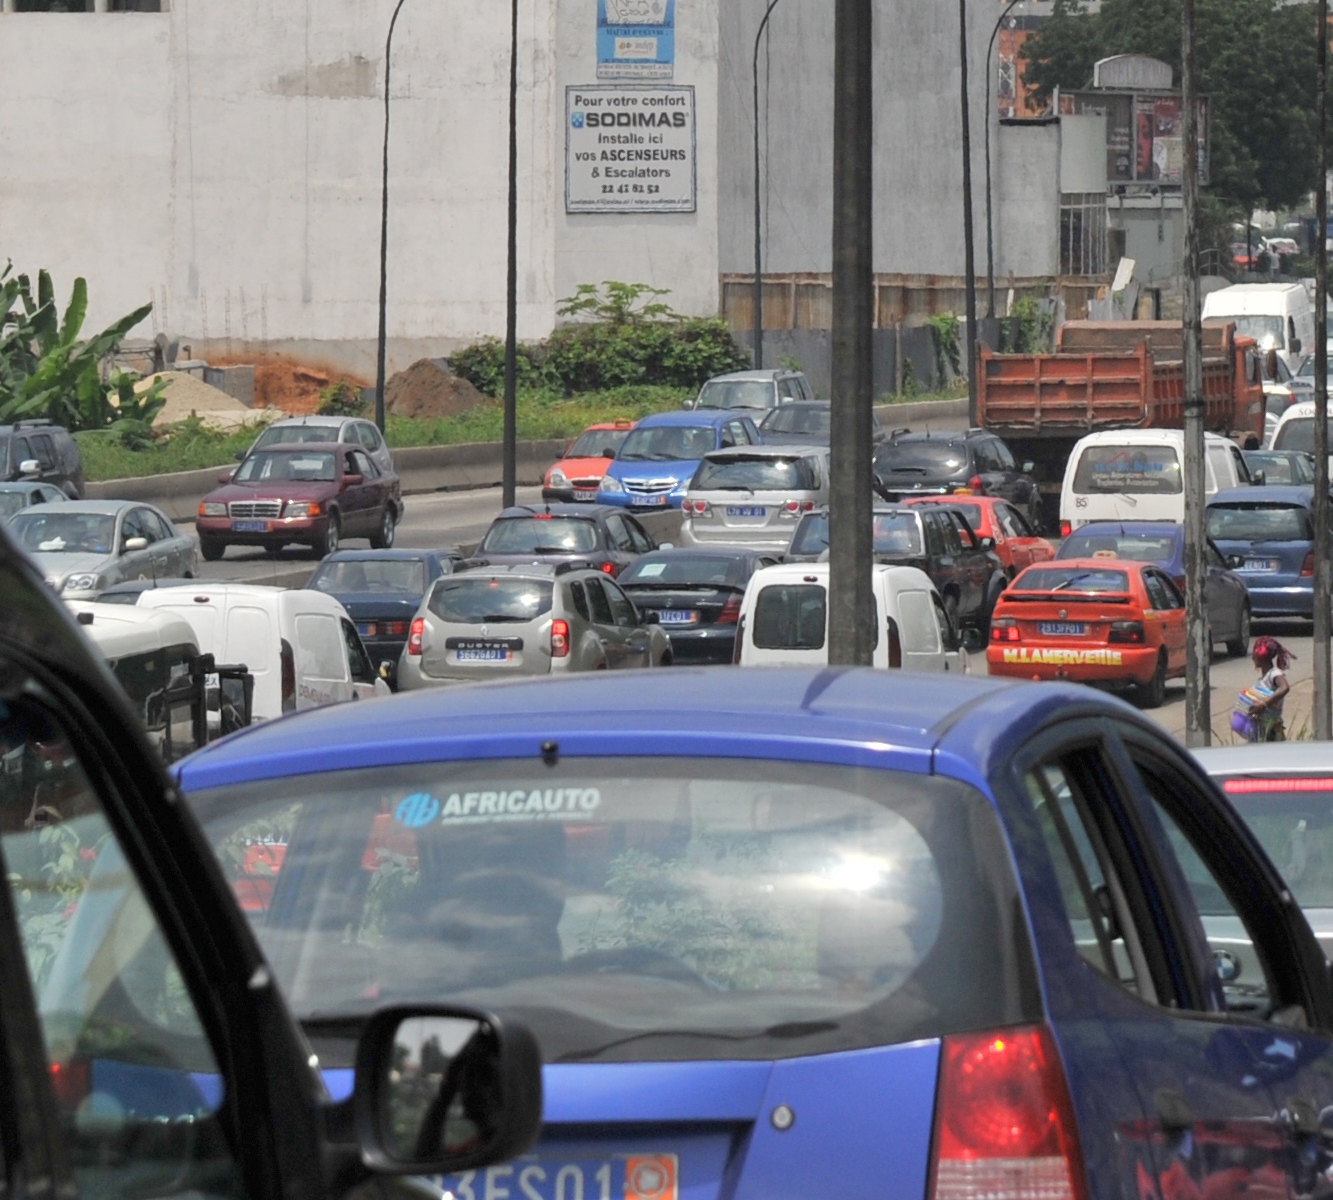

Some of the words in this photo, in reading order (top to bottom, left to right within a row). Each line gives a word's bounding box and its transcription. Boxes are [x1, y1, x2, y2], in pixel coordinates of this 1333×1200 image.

[574, 94, 603, 107] Pour
[606, 96, 638, 107] votre
[641, 94, 686, 106] confort
[585, 111, 686, 128] SODIMAS
[648, 133, 663, 144] ici
[574, 151, 597, 161] vos
[600, 149, 686, 161] ASCENSEURS
[591, 166, 600, 178] &
[604, 166, 671, 178] Escalators
[441, 787, 601, 816] AFRICAUTO
